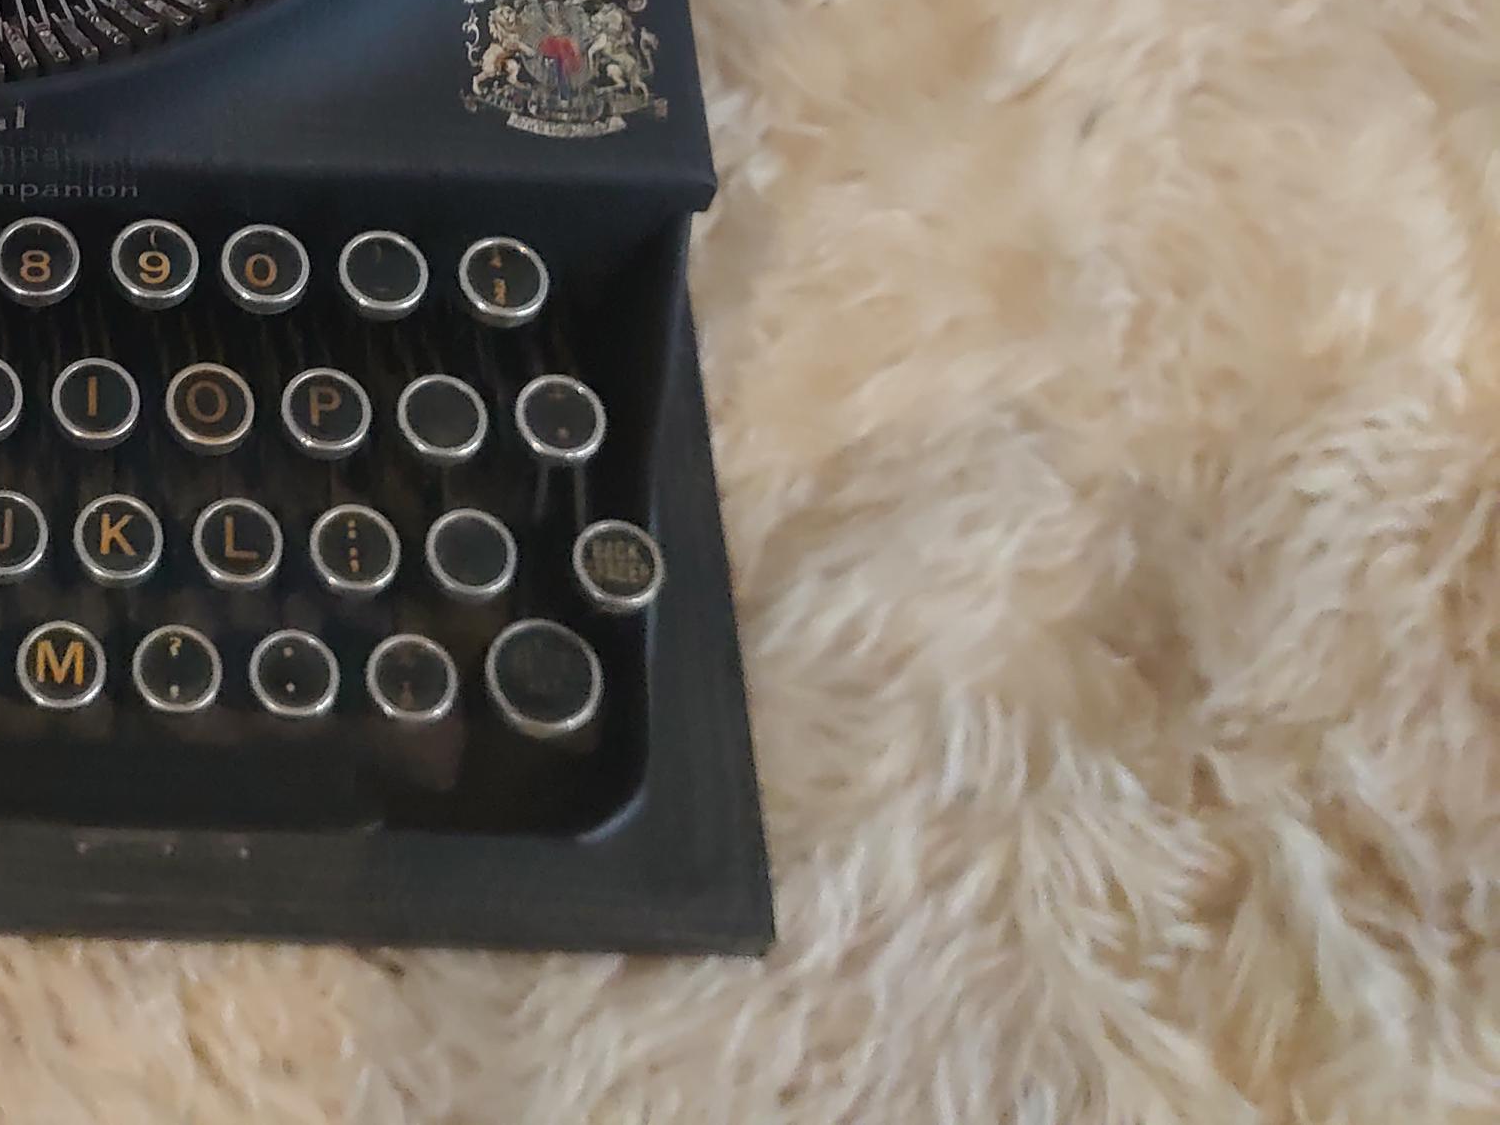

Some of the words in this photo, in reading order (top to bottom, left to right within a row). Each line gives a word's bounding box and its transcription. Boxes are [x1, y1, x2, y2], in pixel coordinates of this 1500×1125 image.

[20, 249, 51, 283] 8
[138, 250, 170, 284] 9
[86, 376, 98, 417] I
[185, 379, 228, 424] O
[309, 385, 342, 427] P
[99, 513, 137, 556] K
[224, 515, 260, 559] L
[36, 639, 84, 686] M
